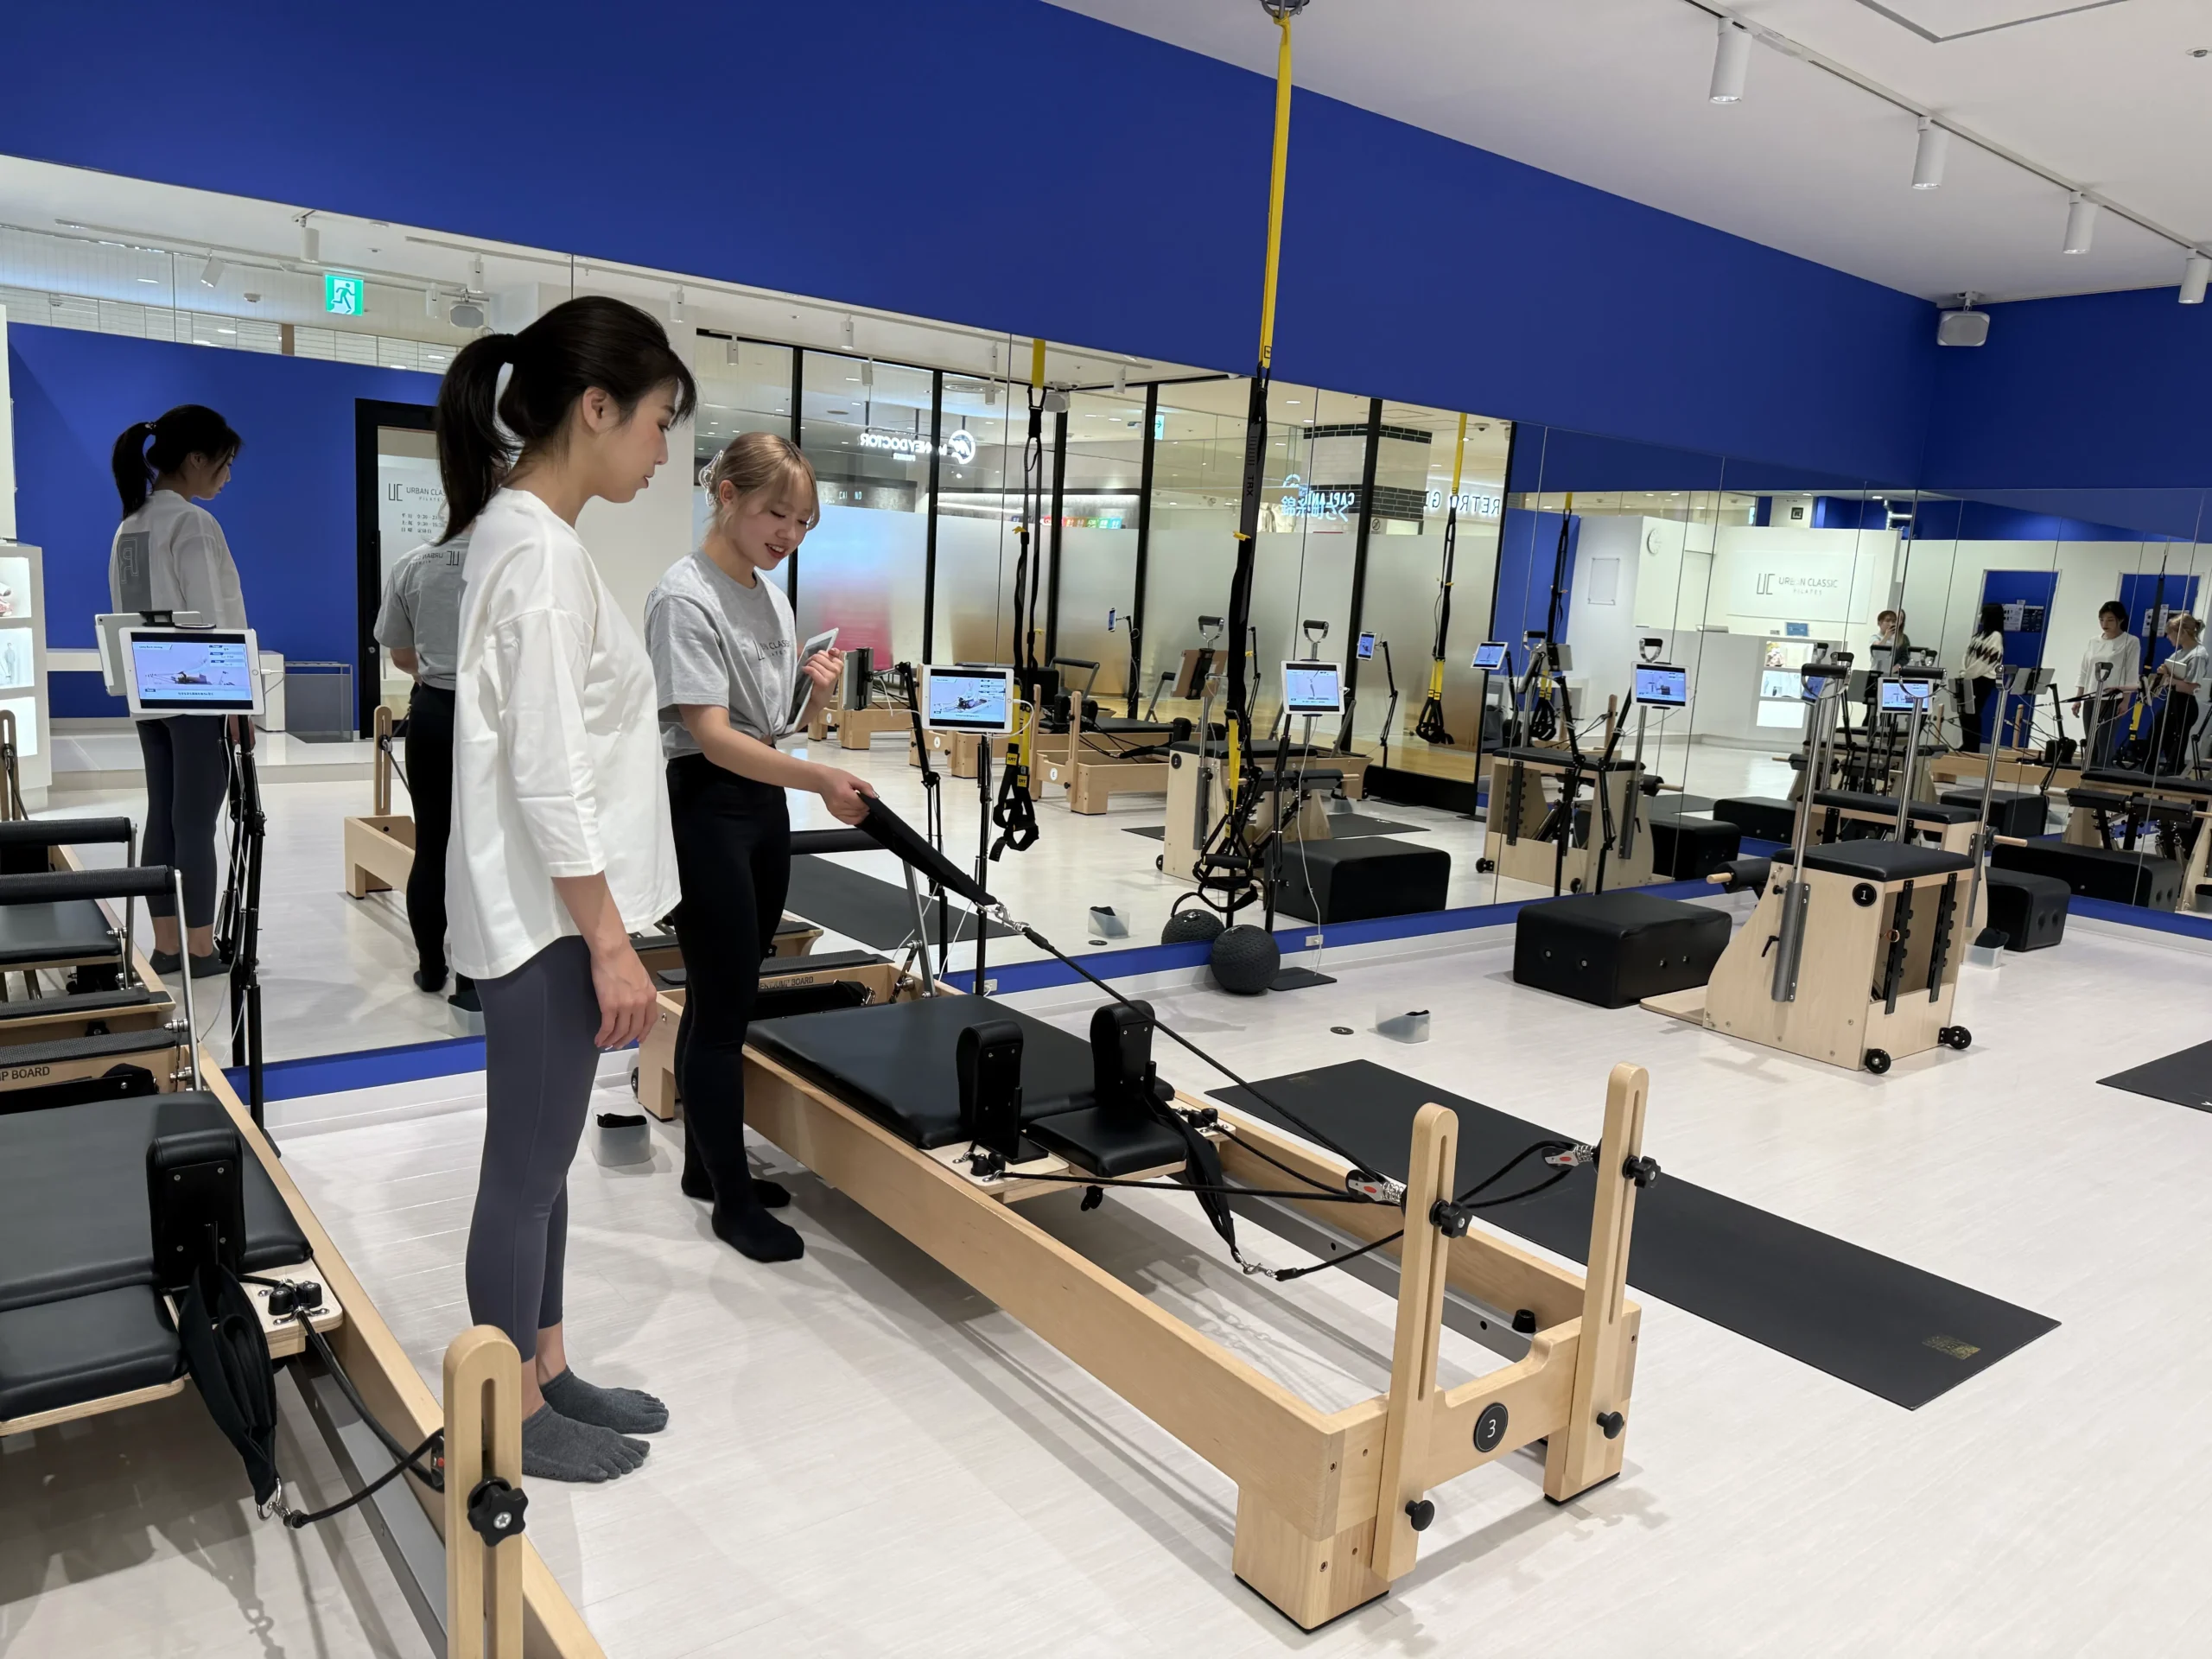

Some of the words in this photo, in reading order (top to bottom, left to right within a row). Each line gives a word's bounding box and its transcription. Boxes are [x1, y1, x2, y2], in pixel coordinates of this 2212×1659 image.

[406, 486, 429, 496] URBAN
[1246, 476, 1255, 497] TRX
[1807, 578, 1839, 588] CLASSIC
[1860, 890, 1867, 900] 1
[791, 976, 814, 987] BOARD
[0, 1071, 9, 1082] P
[11, 1066, 50, 1080] BOARD
[1486, 1418, 1497, 1439] 3
